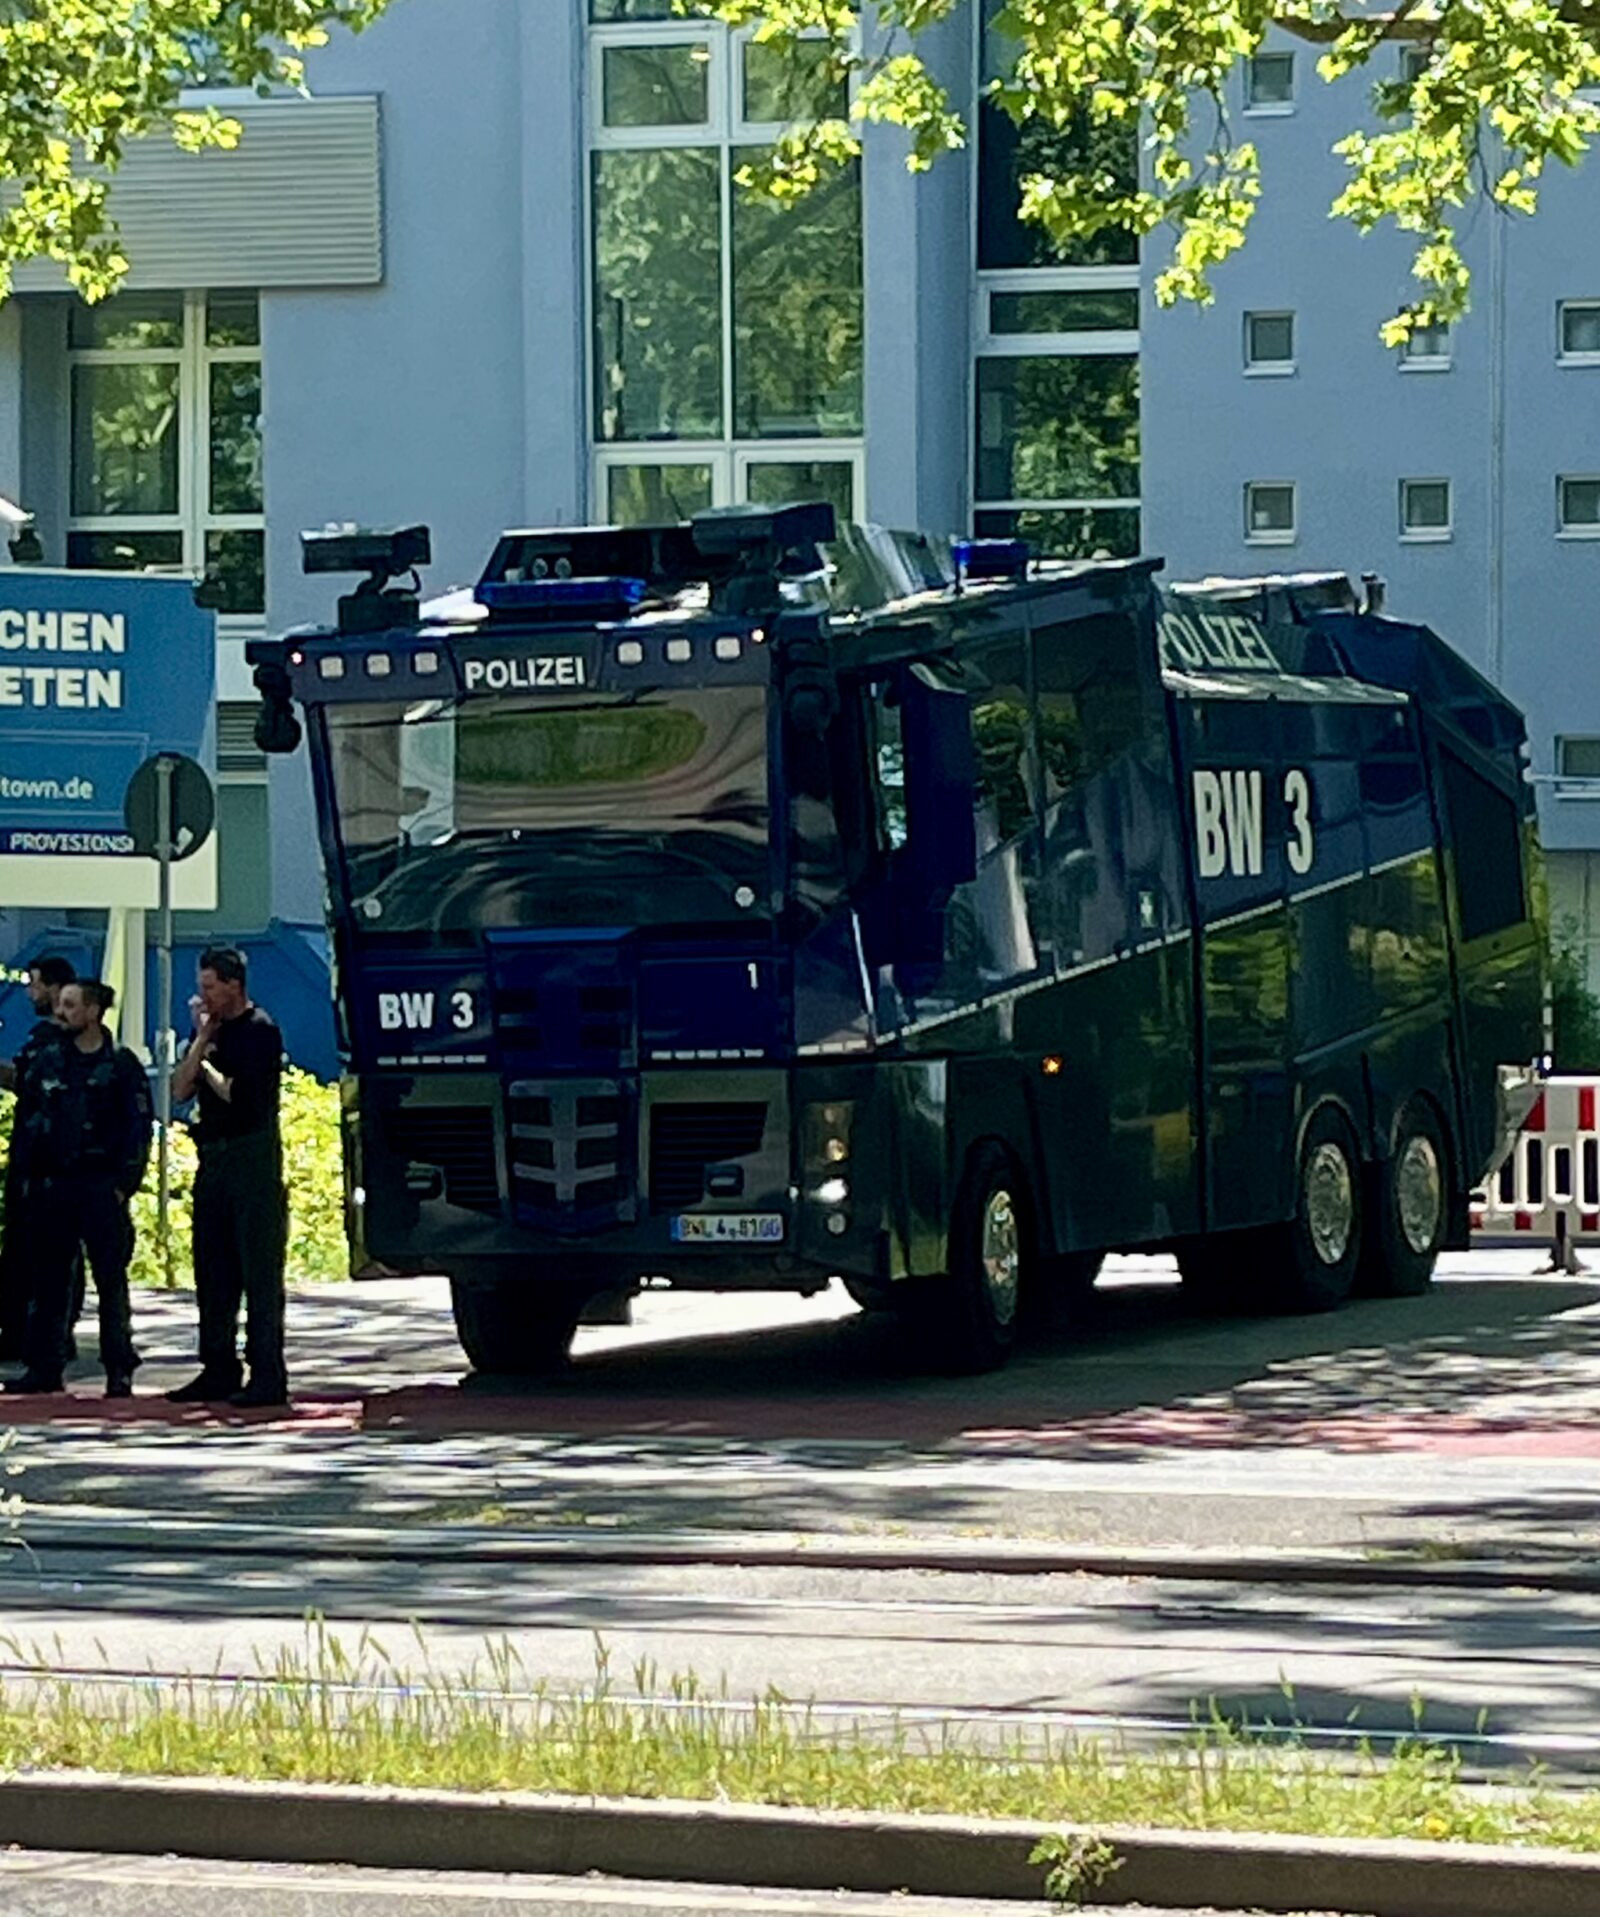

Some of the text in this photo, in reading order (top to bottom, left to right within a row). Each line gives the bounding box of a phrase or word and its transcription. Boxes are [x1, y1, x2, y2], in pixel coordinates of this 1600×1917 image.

[0, 609, 125, 653] CHEN
[0, 666, 121, 708] ETEN
[464, 656, 585, 689] POLIZEI
[0, 776, 94, 799] town.de
[1192, 769, 1314, 877] BW 3
[9, 832, 135, 852] PROVISIONS
[747, 962, 759, 990] 1
[378, 991, 474, 1029] BW 3
